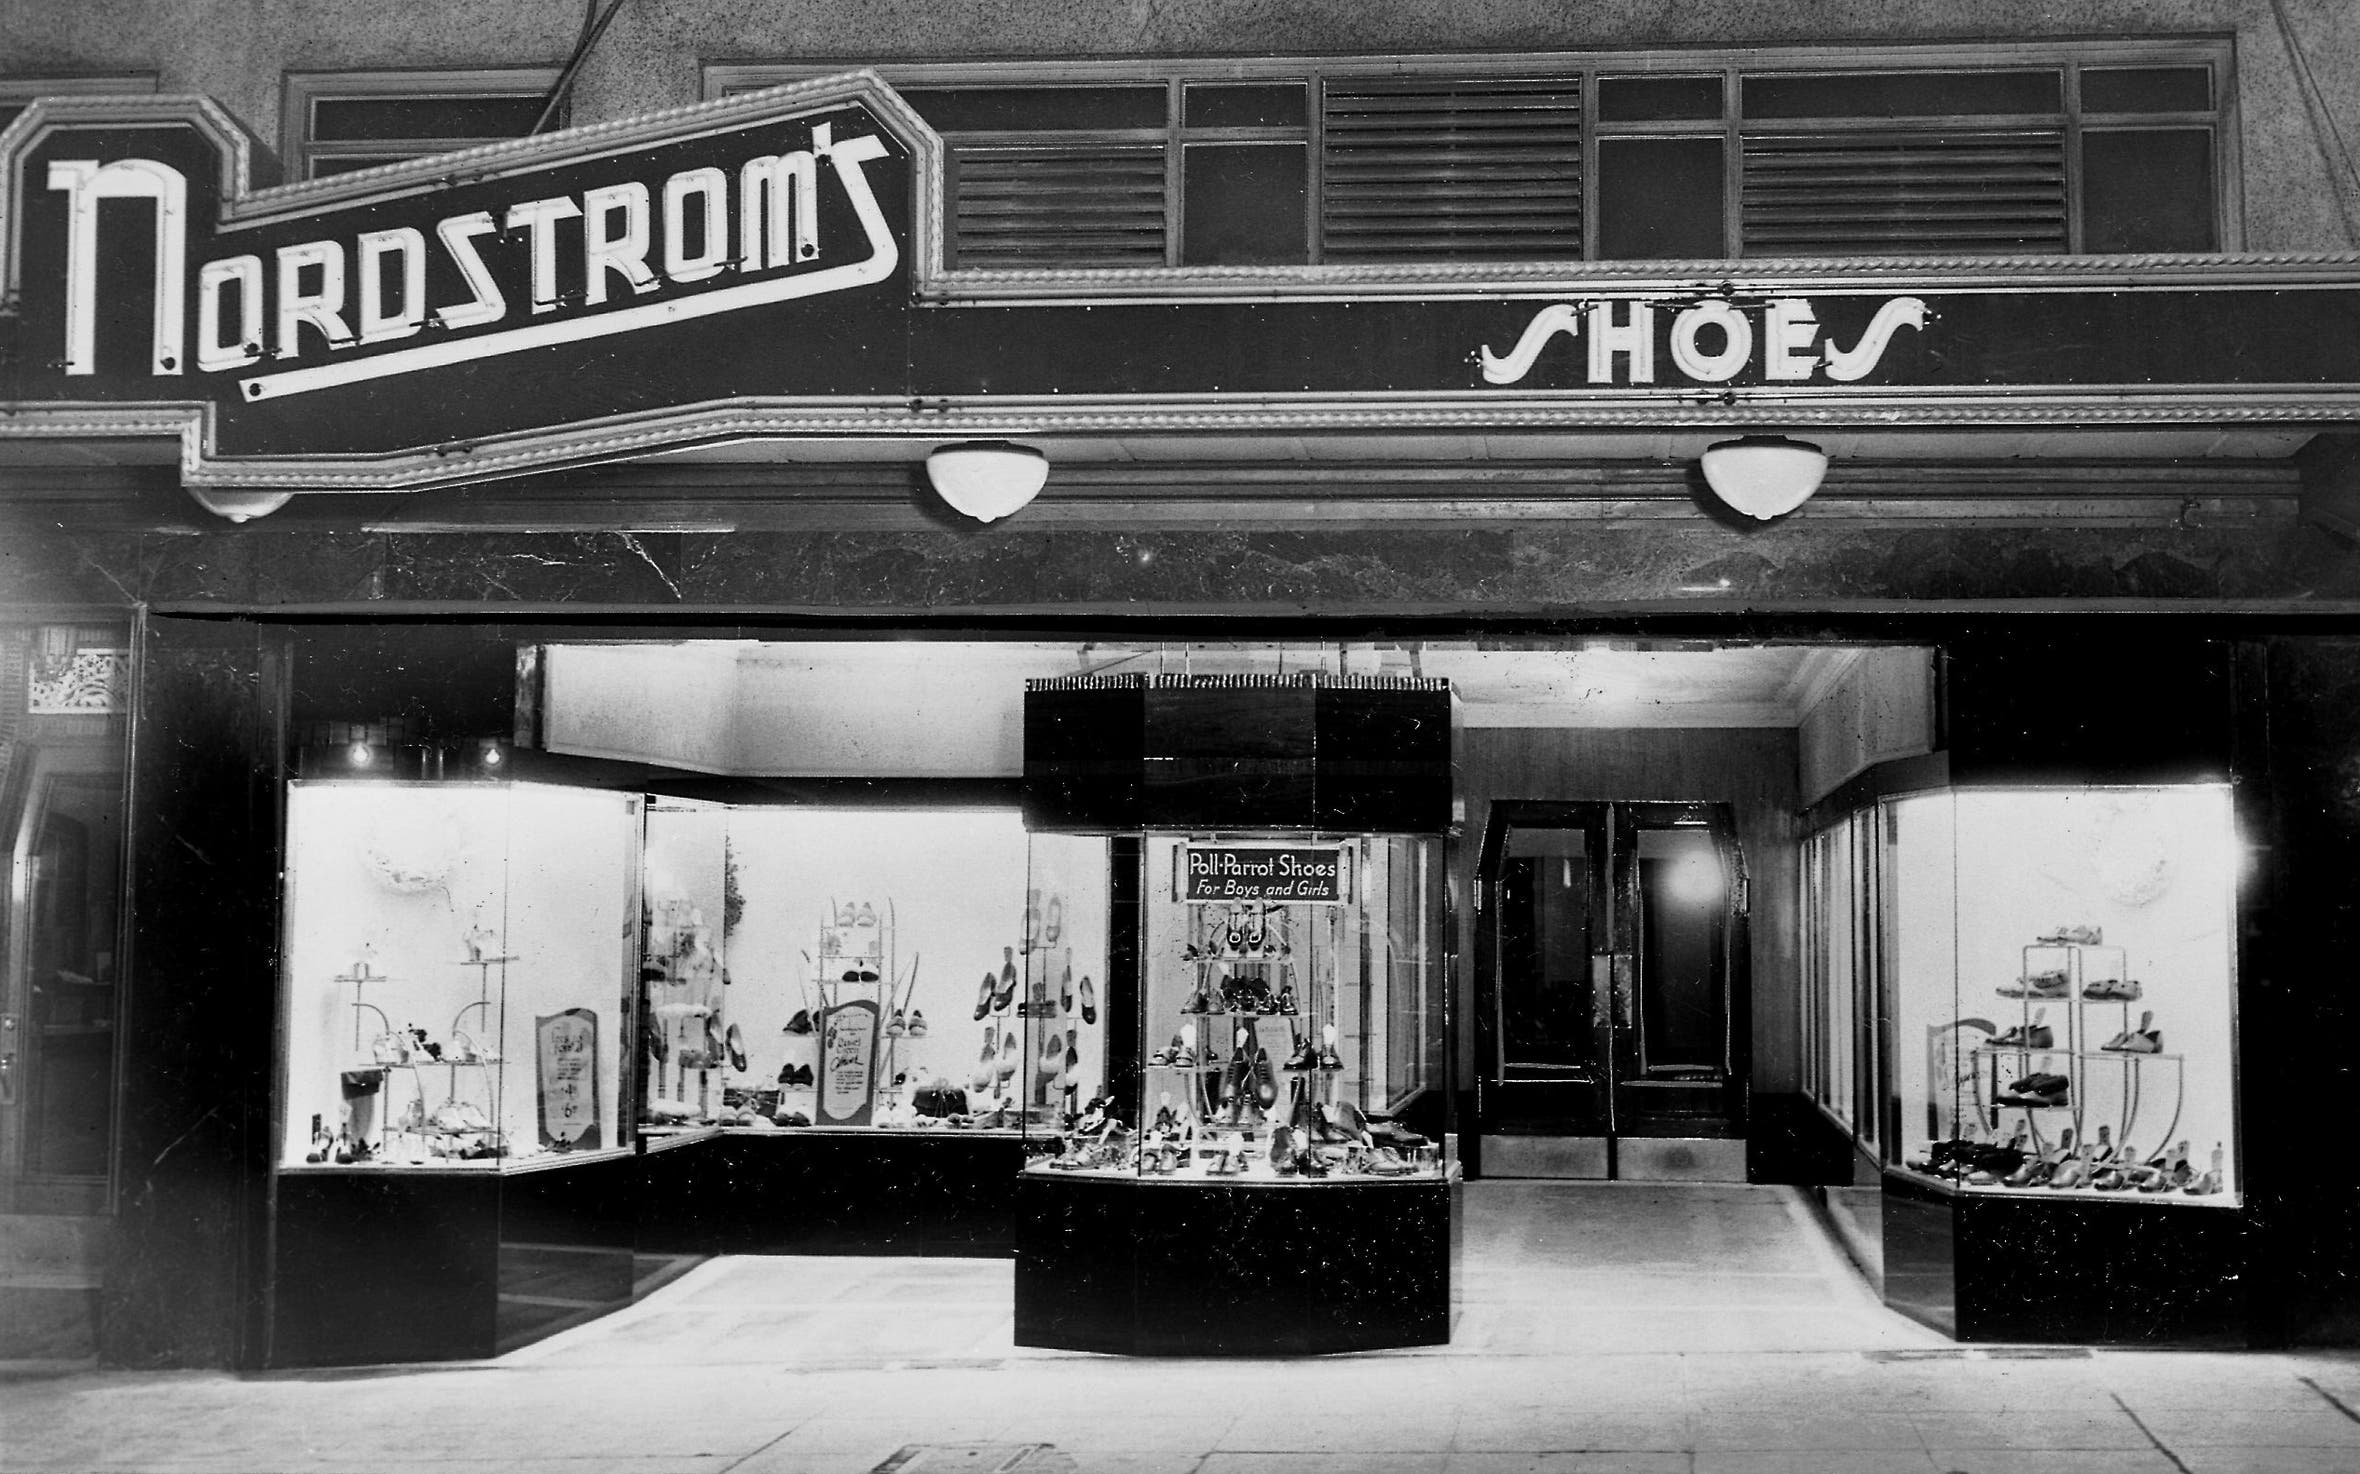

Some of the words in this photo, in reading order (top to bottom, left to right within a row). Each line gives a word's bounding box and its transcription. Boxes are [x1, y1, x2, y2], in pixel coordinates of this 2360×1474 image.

[1481, 296, 1928, 385] SHOES
[1278, 853, 1336, 877] Shoes
[1196, 878, 1220, 895] For
[1224, 879, 1260, 898] Boys
[1265, 880, 1294, 896] and
[1297, 880, 1330, 896] Girls
